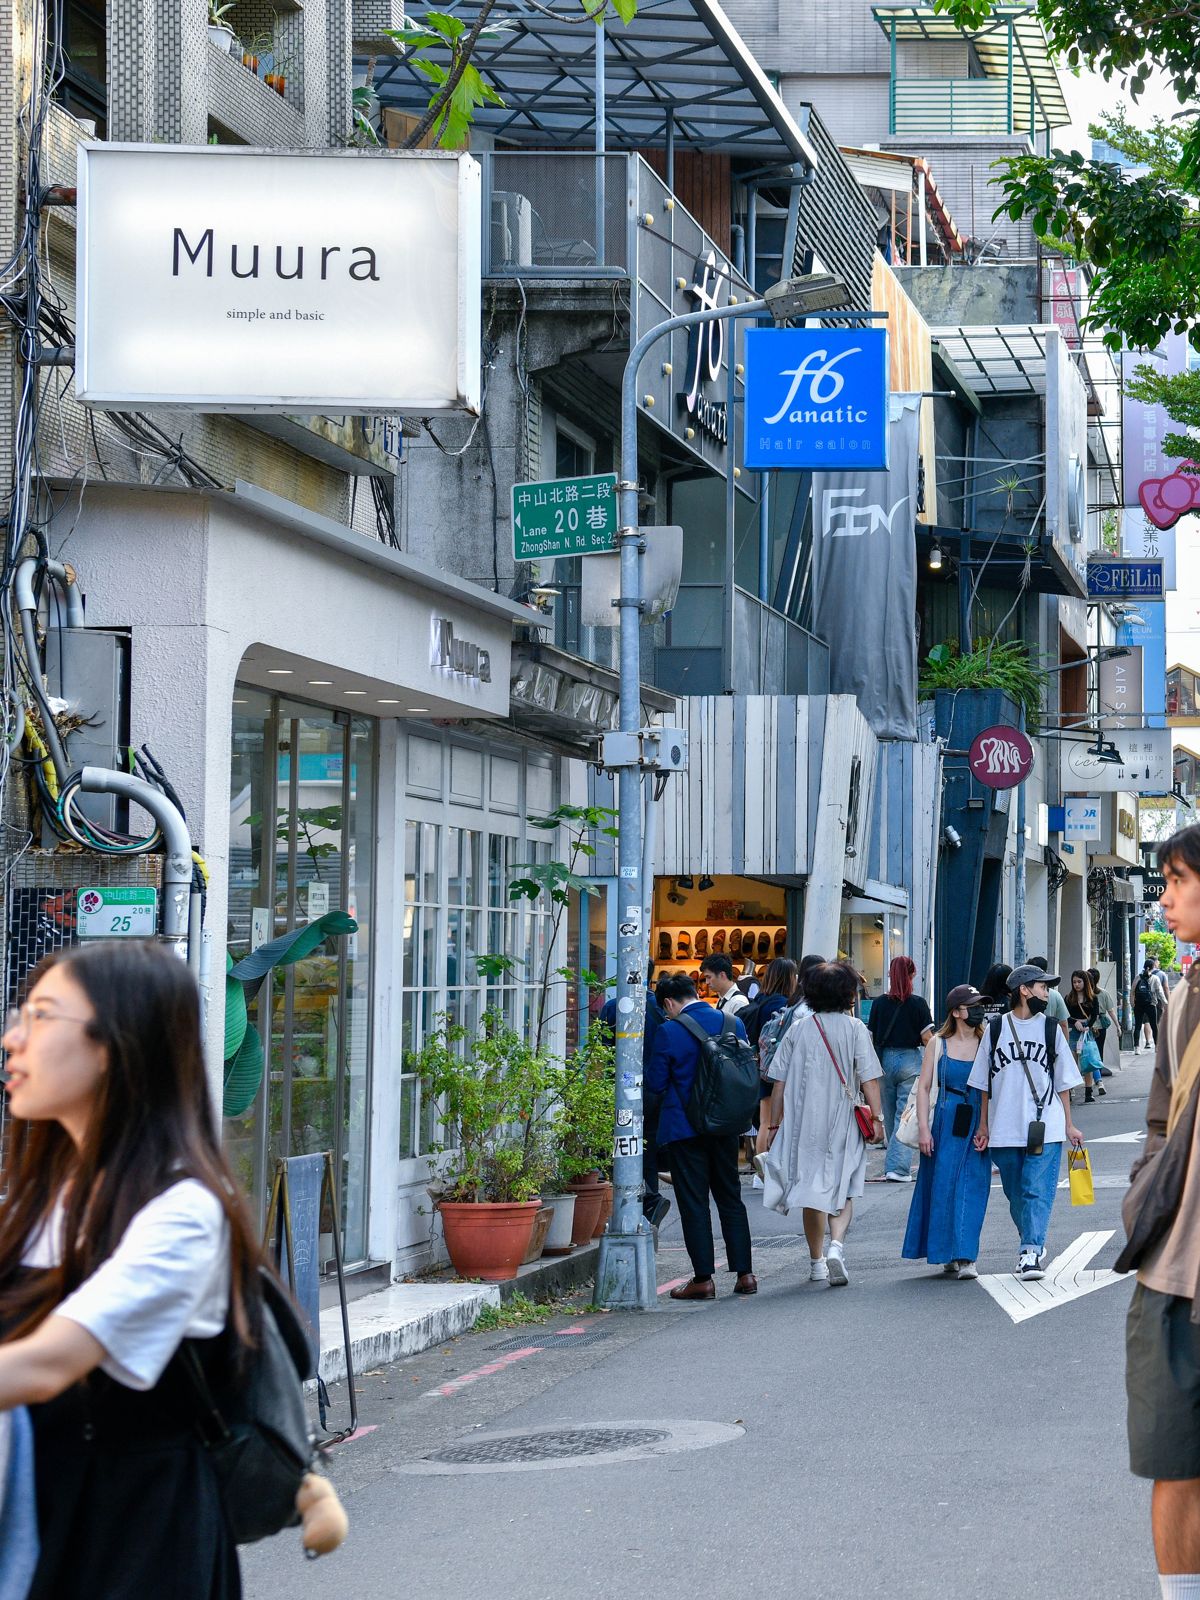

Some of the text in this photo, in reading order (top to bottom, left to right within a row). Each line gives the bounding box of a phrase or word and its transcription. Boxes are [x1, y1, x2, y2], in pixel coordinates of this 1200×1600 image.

[172, 227, 380, 281] Muura
[226, 309, 325, 322] simple and basic
[764, 347, 862, 424] f6
[759, 437, 871, 450] Hair salon
[518, 482, 611, 508] 中山北路二段
[523, 505, 608, 537] Lane 20 巷
[521, 540, 560, 553] ZhongShan
[564, 537, 572, 548] N.
[576, 536, 587, 547] Rd.
[1115, 665, 1126, 694] AIR
[111, 916, 131, 932] 25
[990, 1040, 1051, 1080] AUTI
